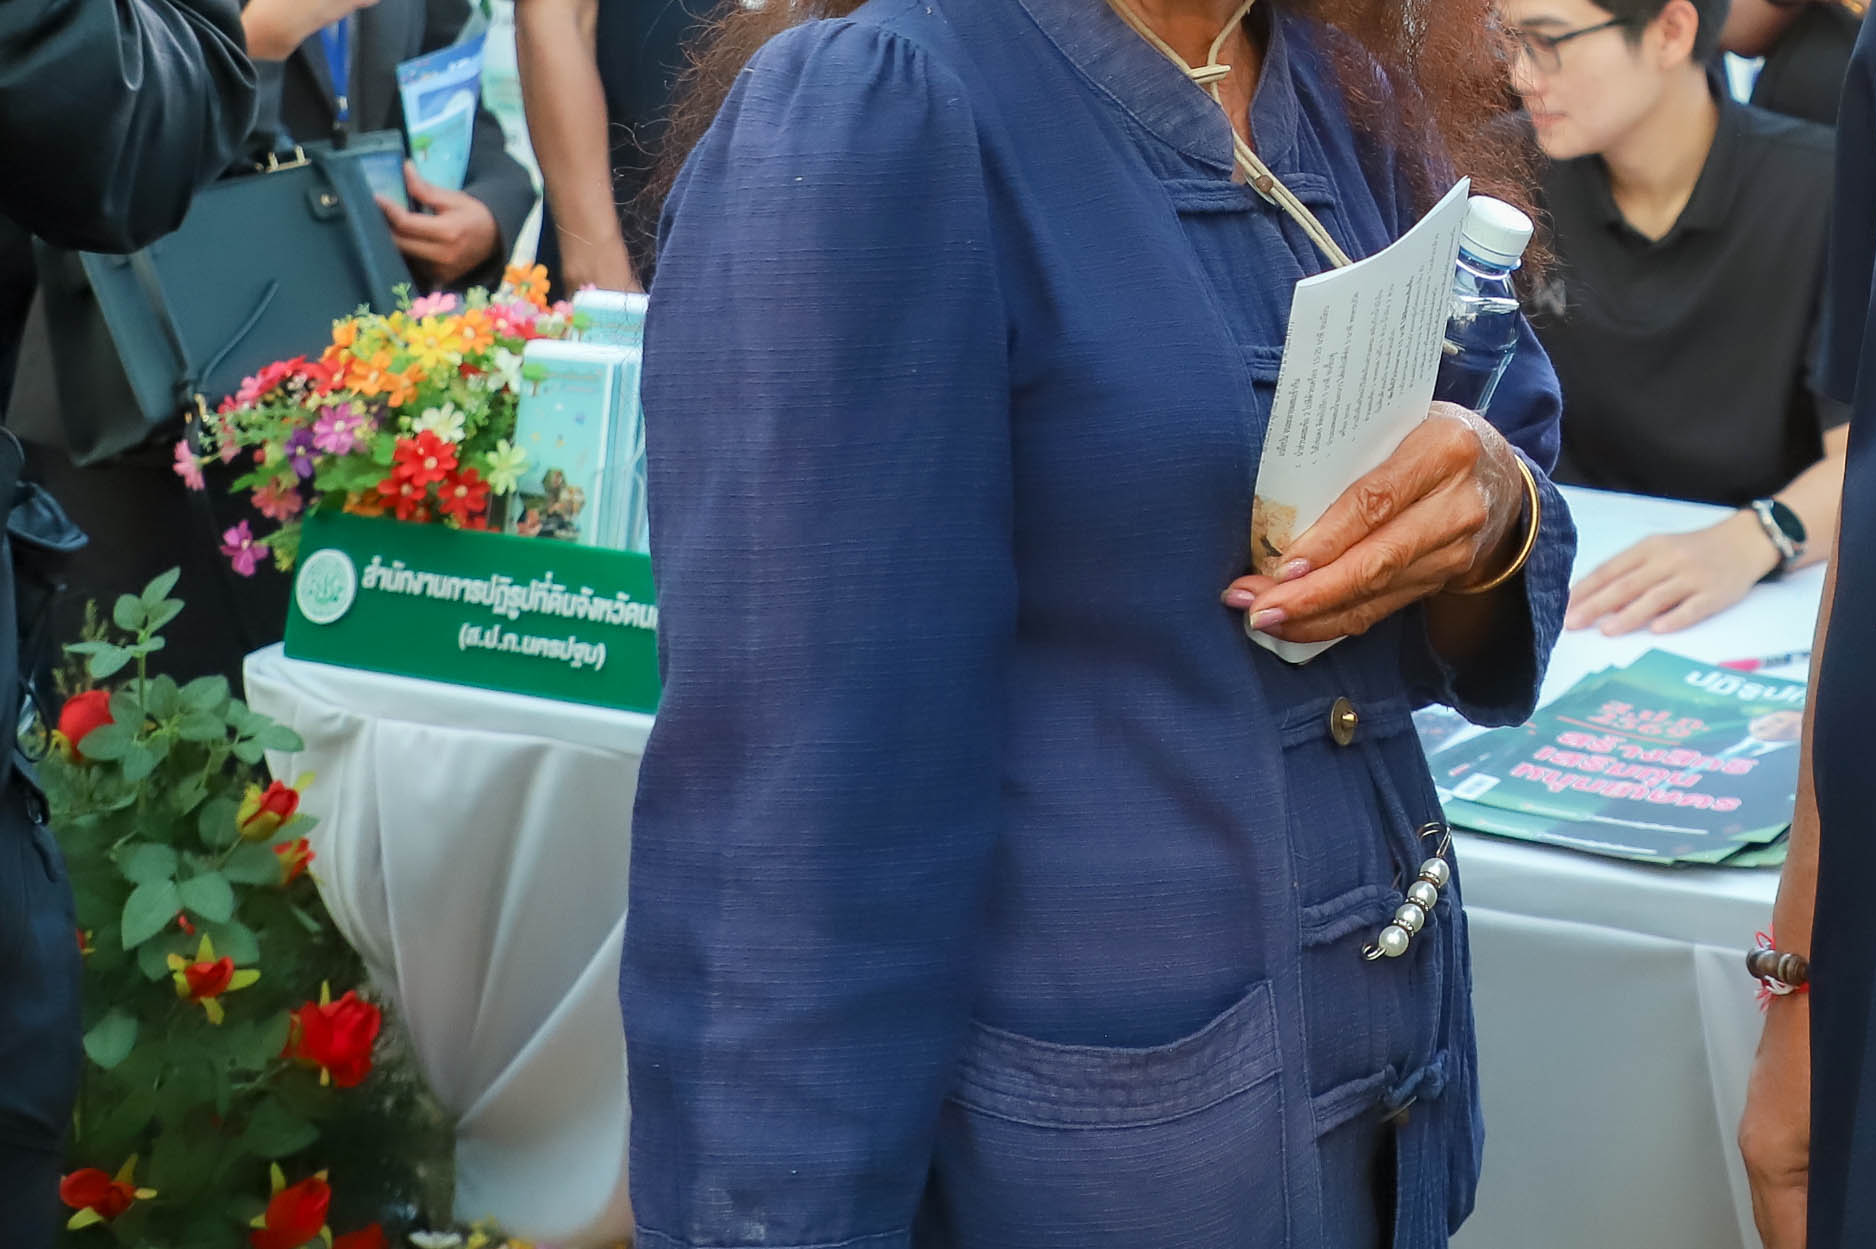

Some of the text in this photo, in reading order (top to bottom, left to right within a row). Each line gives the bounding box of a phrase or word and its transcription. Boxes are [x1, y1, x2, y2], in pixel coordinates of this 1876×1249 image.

[362, 555, 657, 630] สำนักงานการปฏิรูปที่ดินจังหวัดน
